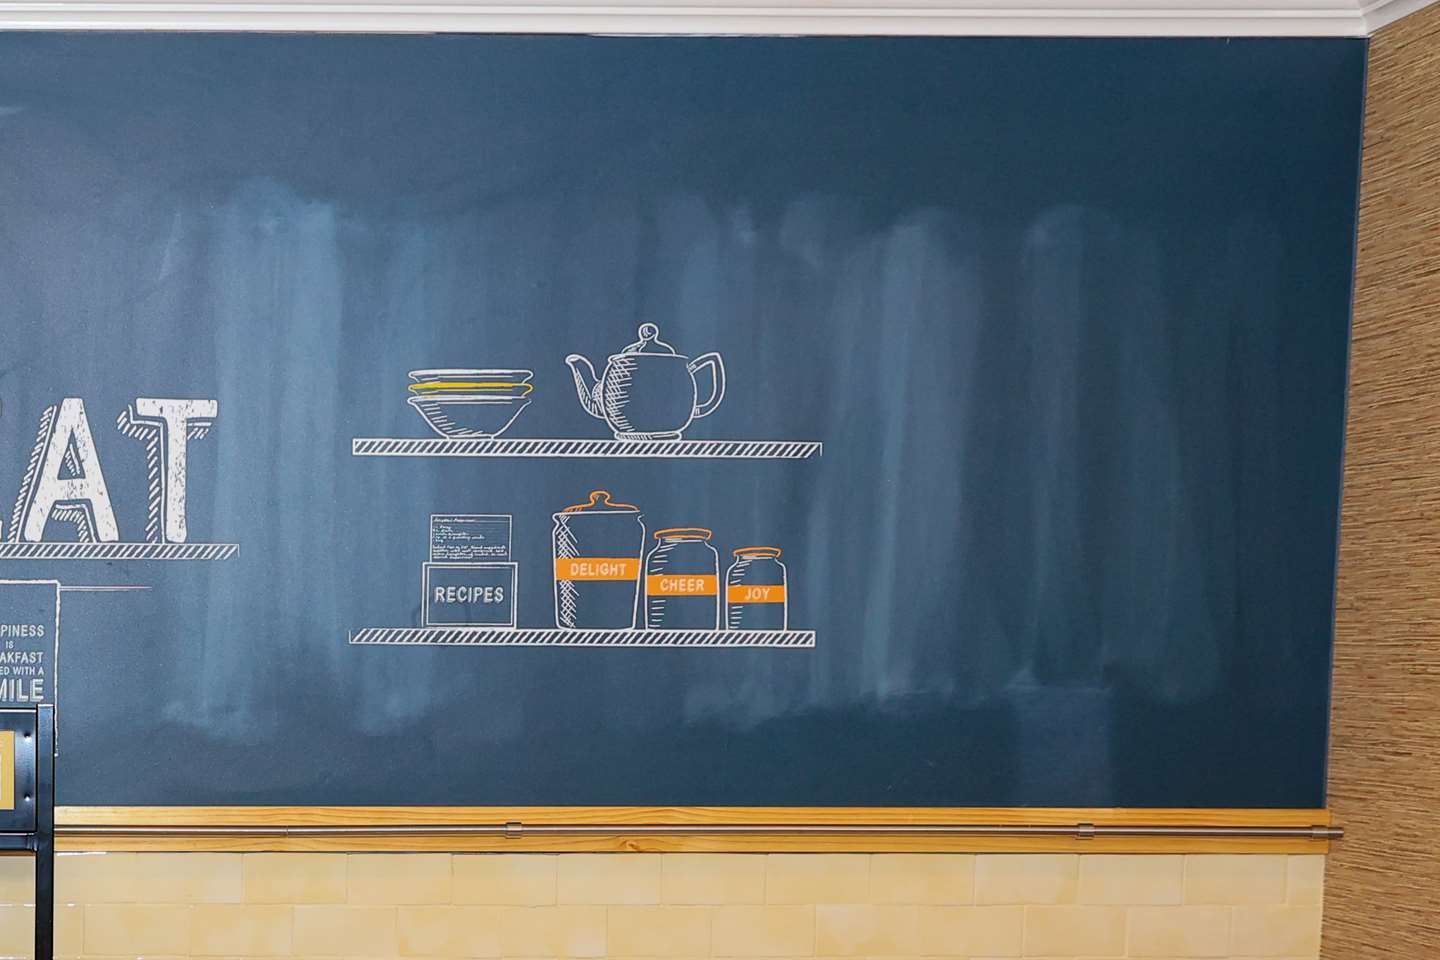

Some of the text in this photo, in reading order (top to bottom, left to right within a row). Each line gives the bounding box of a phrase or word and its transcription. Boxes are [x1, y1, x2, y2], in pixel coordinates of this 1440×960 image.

[570, 563, 626, 577] DELIGHT
[660, 579, 705, 592] CHEER
[435, 586, 504, 603] RECIPES
[744, 588, 771, 601] JOY
[5, 640, 14, 649] IS
[13, 666, 35, 675] WITH
[37, 666, 44, 675] A
